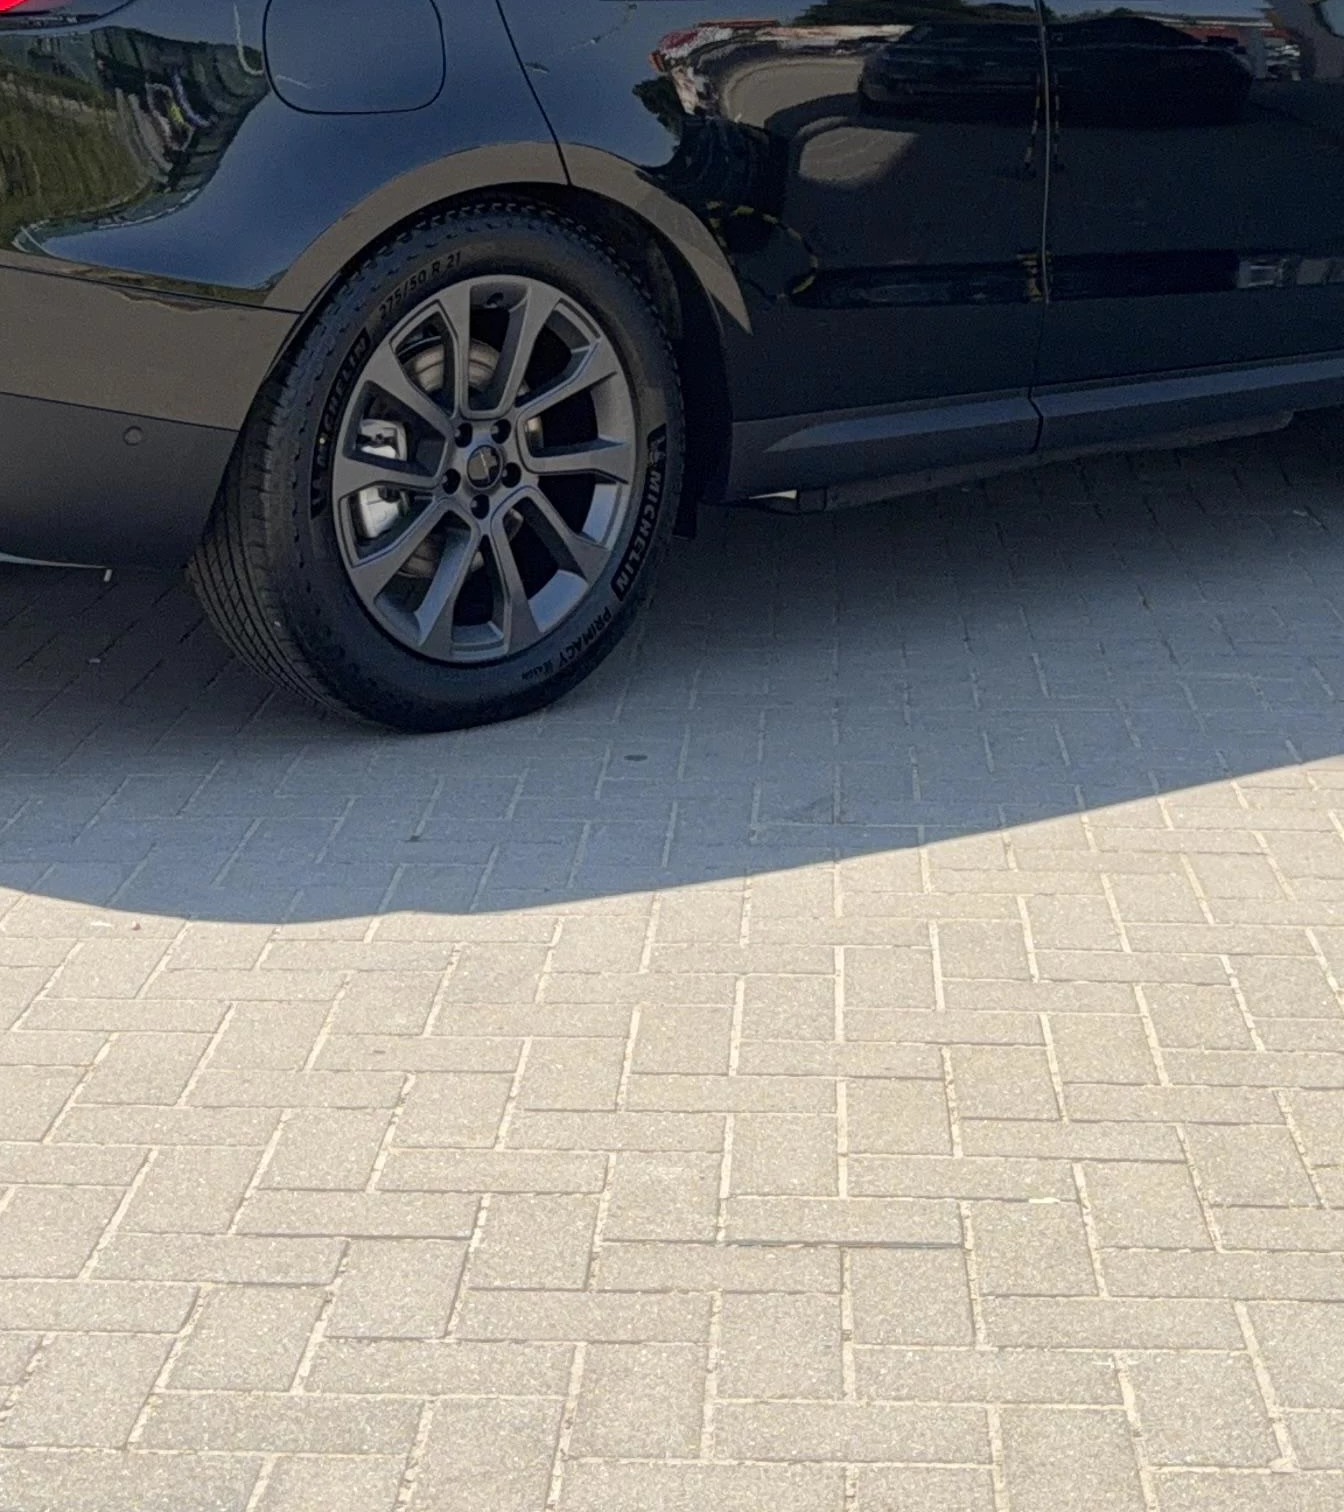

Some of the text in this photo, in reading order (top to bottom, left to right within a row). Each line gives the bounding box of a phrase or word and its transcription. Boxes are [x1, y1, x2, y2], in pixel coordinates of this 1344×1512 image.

[431, 260, 441, 275] R
[447, 250, 462, 269] 21
[615, 470, 662, 593] MICHELIN
[559, 605, 612, 668] PRIMACY
